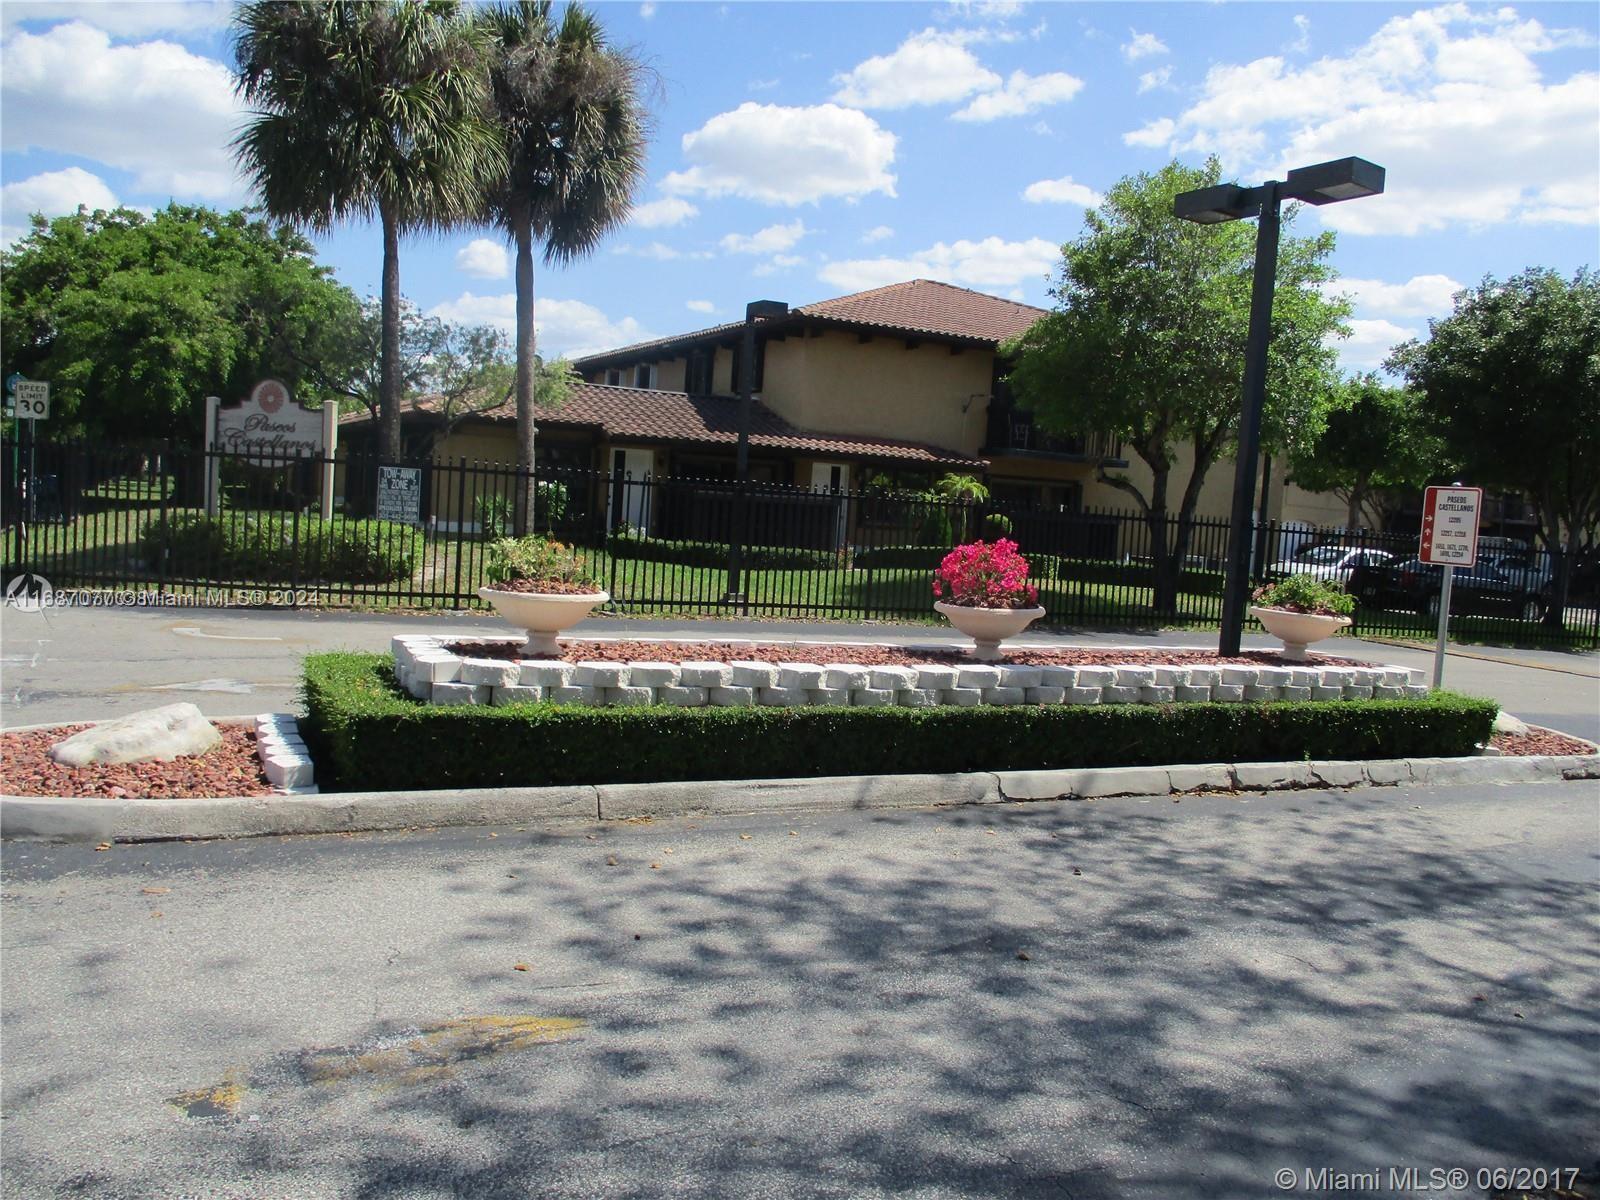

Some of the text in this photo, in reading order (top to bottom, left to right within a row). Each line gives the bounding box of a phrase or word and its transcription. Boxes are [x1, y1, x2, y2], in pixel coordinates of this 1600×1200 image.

[18, 384, 47, 393] SPEED
[20, 400, 45, 414] 30
[244, 413, 297, 433] Paseos
[383, 468, 417, 480] TOW-AWAY
[391, 479, 409, 490] ZONE
[1446, 496, 1467, 504] PASEOS
[1438, 504, 1474, 512] CASTELLANOS
